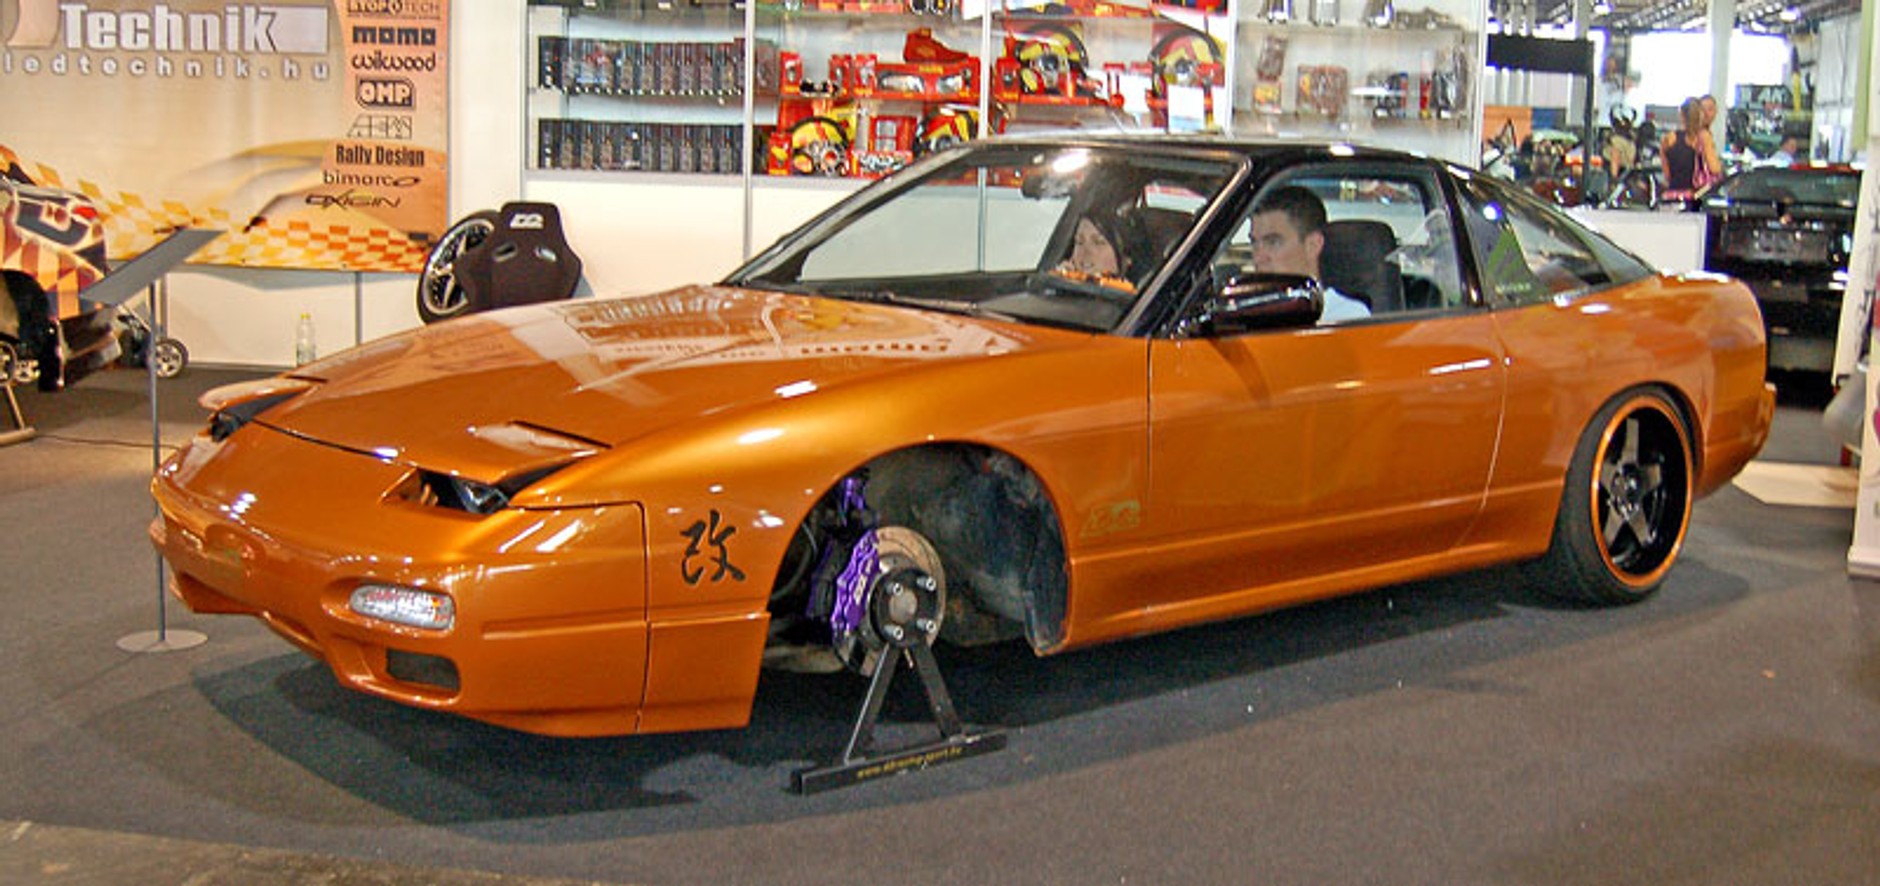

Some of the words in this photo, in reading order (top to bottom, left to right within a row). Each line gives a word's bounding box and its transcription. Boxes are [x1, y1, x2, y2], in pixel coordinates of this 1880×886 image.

[58, 3, 279, 53] Technik
[352, 27, 436, 45] momo
[4, 53, 329, 80] ledtechnik.hu
[352, 49, 436, 71] wilwood
[360, 81, 412, 105] OMP
[336, 144, 372, 165] Rally
[375, 146, 425, 167] Design
[323, 169, 421, 187] bimarco
[680, 508, 746, 586] 改
